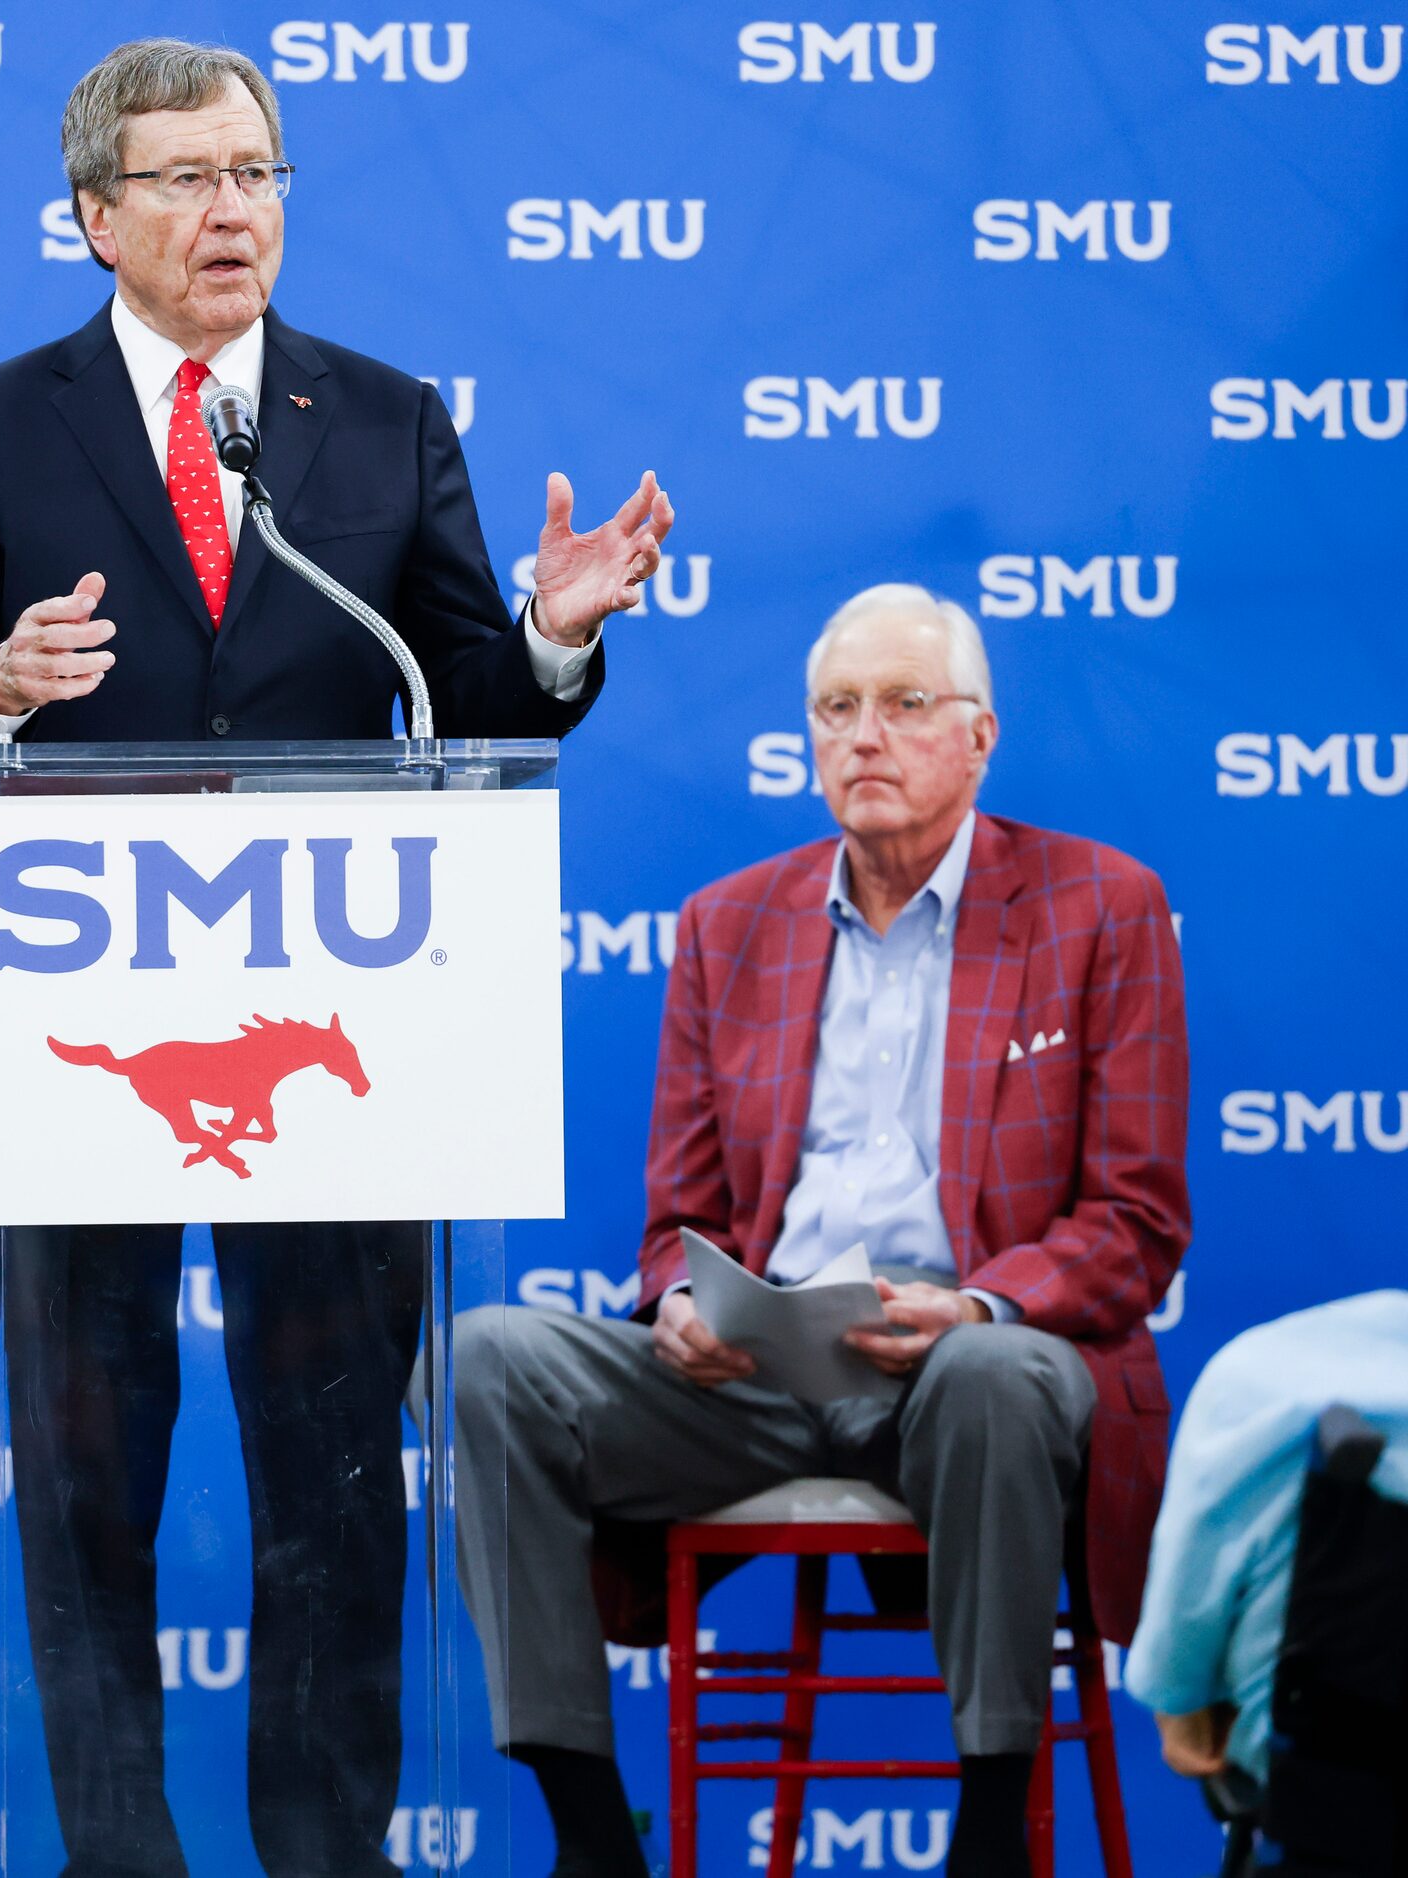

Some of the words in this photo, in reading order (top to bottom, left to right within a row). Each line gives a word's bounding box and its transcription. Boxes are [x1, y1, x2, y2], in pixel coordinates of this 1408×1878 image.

[271, 21, 469, 82] SMU
[738, 22, 936, 83] SMU
[1205, 24, 1403, 85] SMU
[507, 199, 705, 260] SMU
[974, 200, 1171, 261] SMU
[744, 377, 942, 438] SMU
[1210, 378, 1408, 440] SMU
[979, 555, 1178, 618] SMU
[1216, 733, 1408, 796] SMU
[518, 1268, 638, 1318] SM
